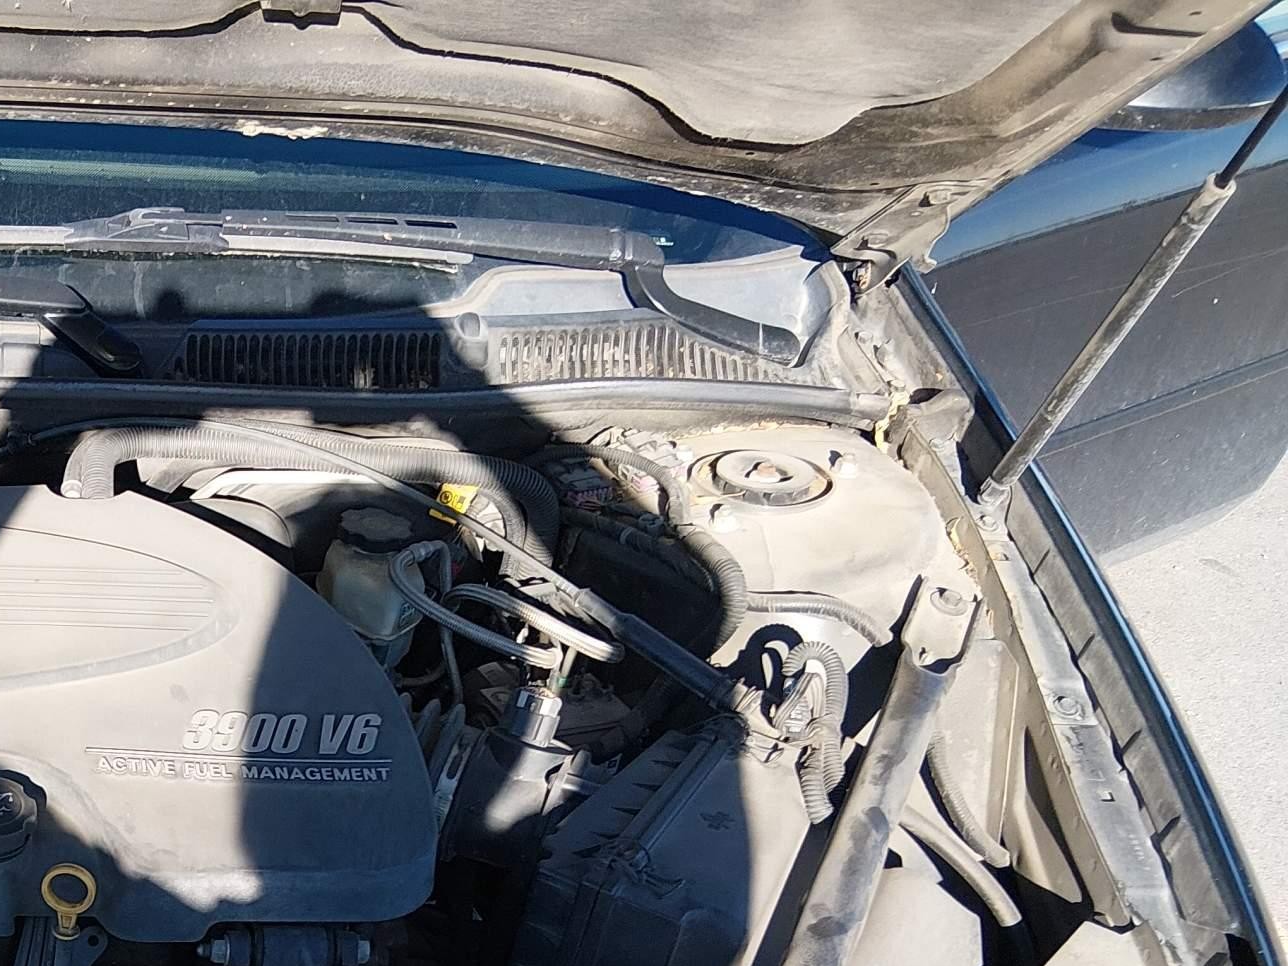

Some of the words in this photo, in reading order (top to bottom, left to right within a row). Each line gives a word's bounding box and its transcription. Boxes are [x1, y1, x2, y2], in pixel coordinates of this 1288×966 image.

[183, 709, 308, 753] 3900
[319, 713, 382, 755] V6
[96, 755, 176, 776] ACTIVE
[183, 760, 233, 779] FUEL
[241, 764, 391, 781] MANAGEMENT
